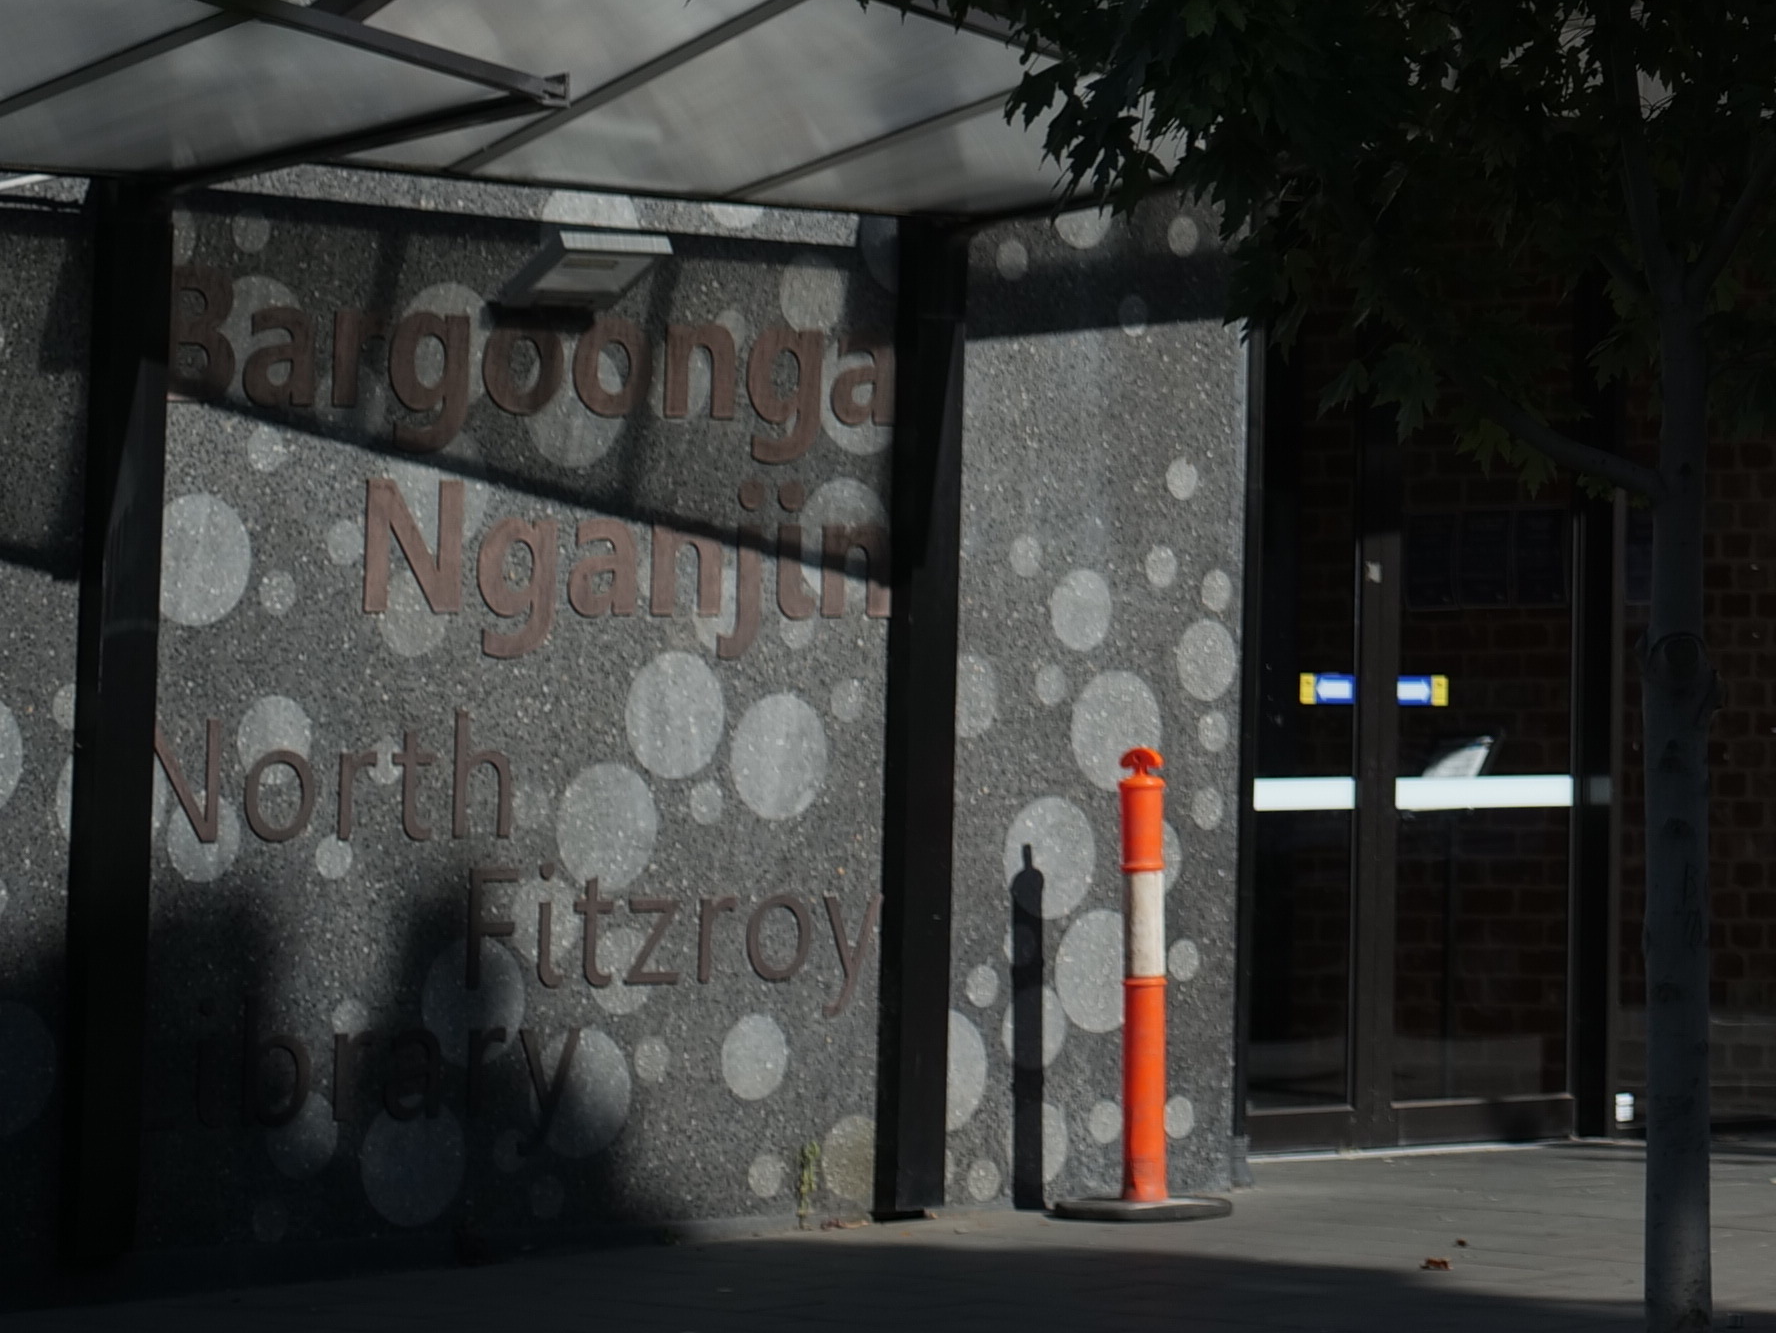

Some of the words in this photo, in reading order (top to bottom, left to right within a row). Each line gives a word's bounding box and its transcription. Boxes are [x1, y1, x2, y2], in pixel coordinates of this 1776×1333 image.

[362, 477, 893, 659] Nganjin
[464, 863, 886, 1020] Fitzroy
[143, 993, 582, 1157] ibrary
